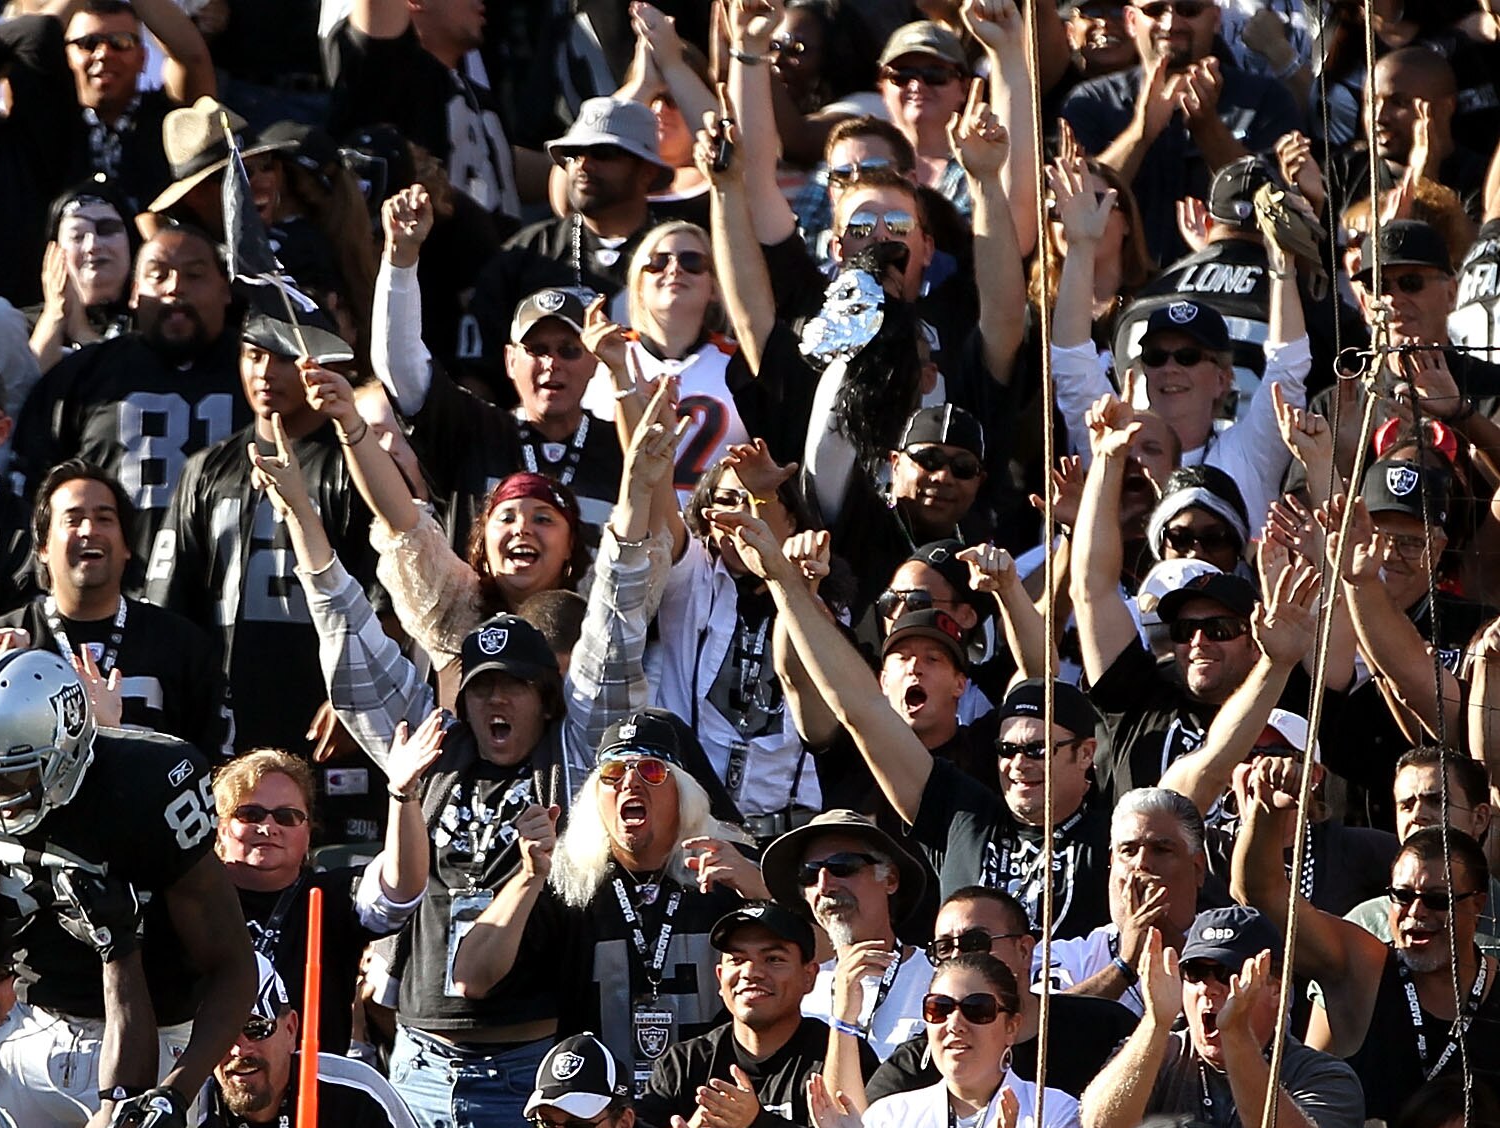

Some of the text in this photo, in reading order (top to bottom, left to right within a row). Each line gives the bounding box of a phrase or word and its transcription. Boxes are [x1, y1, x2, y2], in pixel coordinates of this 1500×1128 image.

[1177, 263, 1263, 294] LONG
[117, 391, 234, 508] 81
[612, 878, 636, 923] RAIDERS
[653, 923, 672, 970] RAIDERS
[1404, 982, 1423, 1027] RAIDERS
